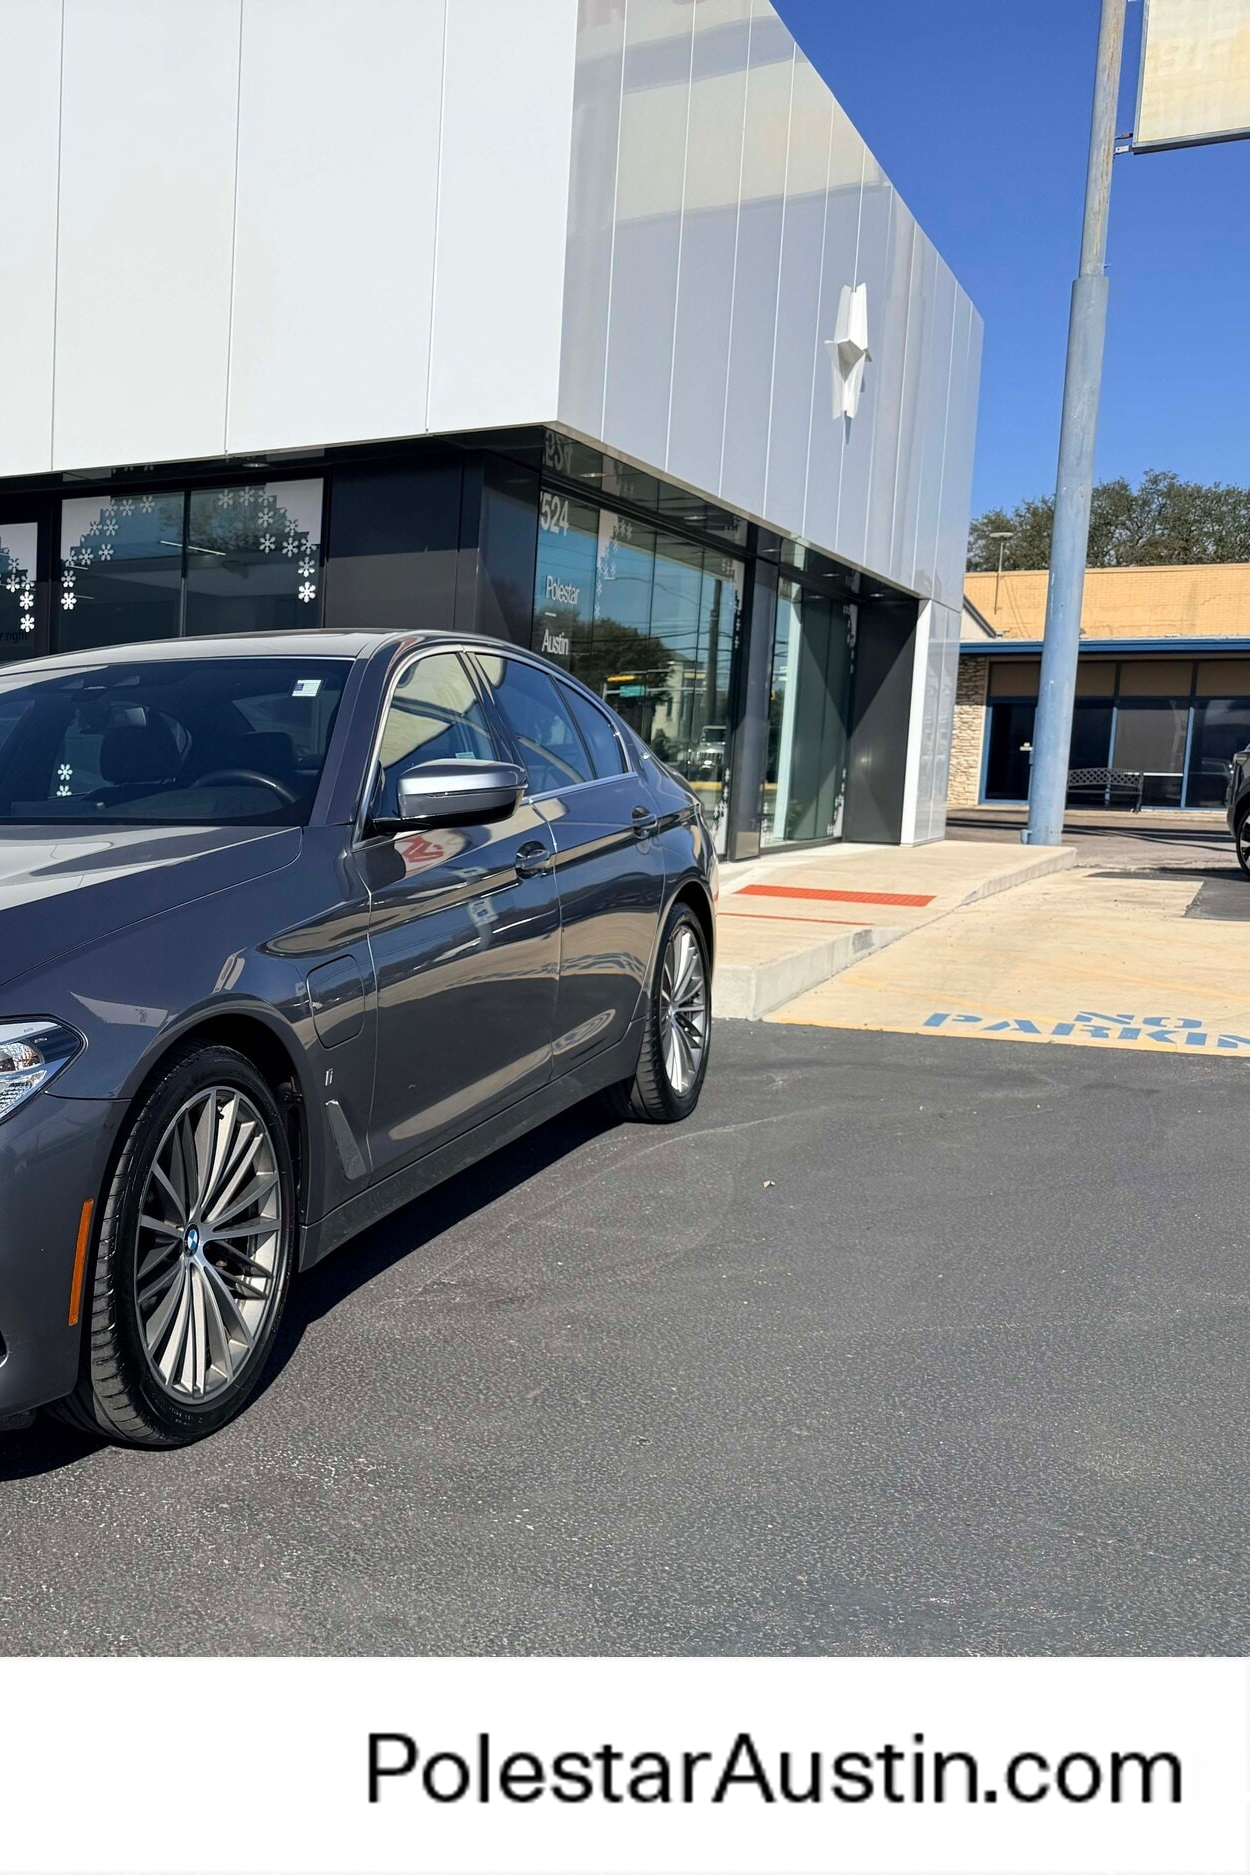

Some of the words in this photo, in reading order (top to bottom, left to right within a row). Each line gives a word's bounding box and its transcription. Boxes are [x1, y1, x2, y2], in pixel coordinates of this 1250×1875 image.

[539, 491, 569, 536] 524
[546, 575, 580, 605] Polestar
[542, 628, 569, 655] Austin
[1073, 1011, 1203, 1029] NO
